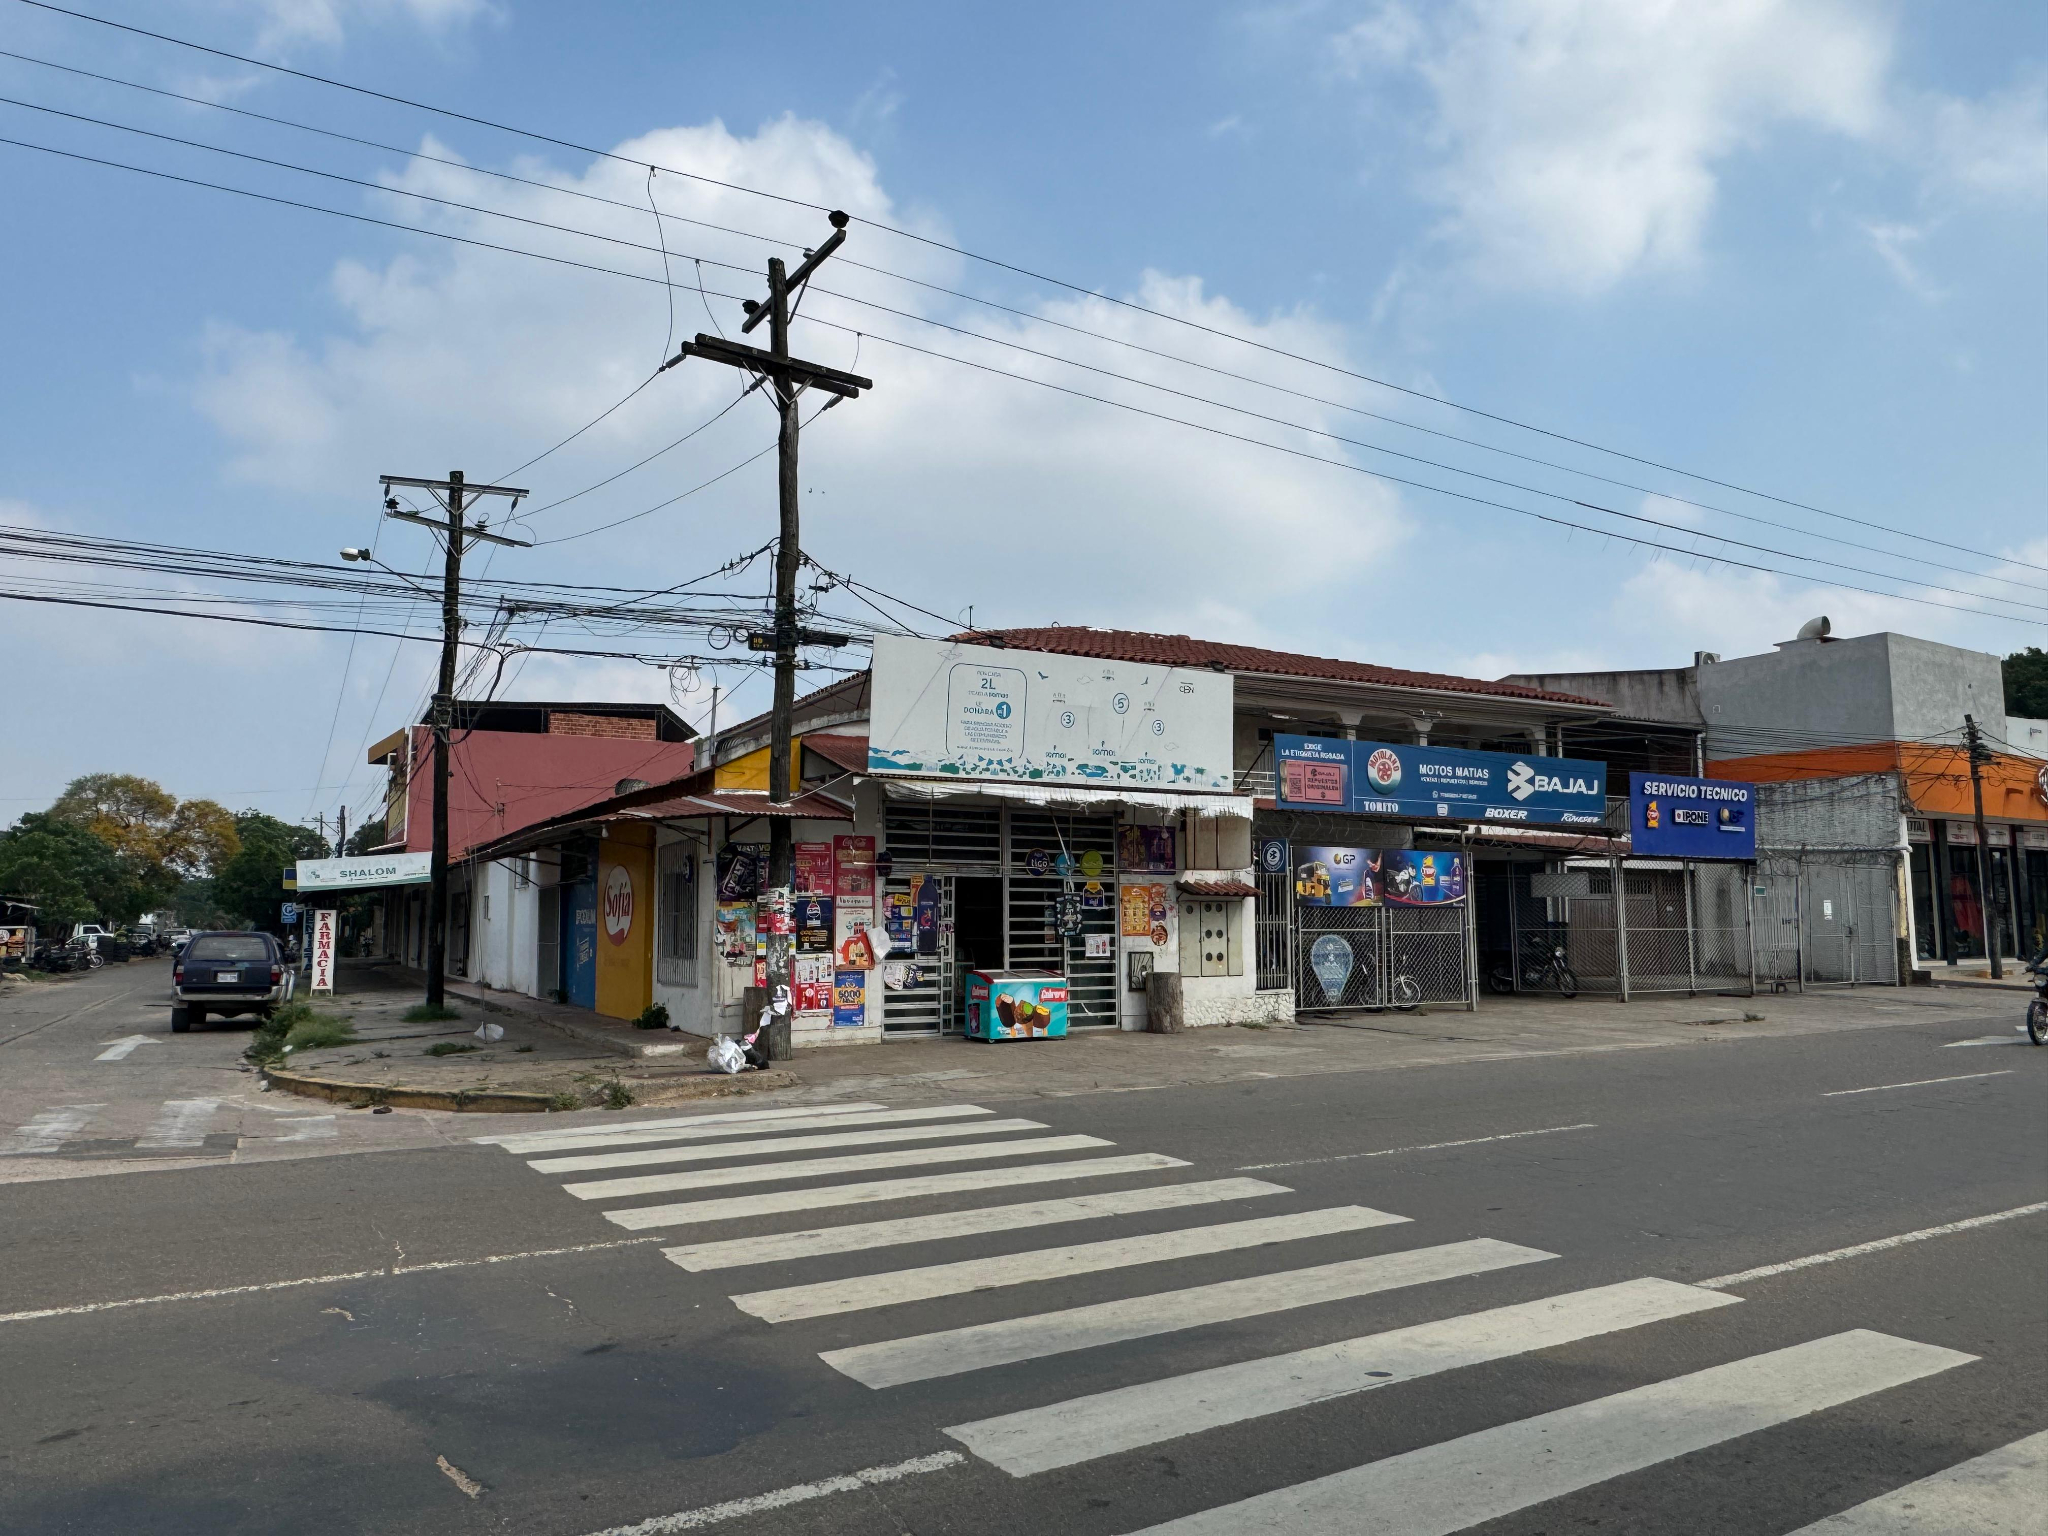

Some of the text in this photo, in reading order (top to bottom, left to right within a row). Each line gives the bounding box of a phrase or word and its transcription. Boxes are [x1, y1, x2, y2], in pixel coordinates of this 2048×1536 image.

[981, 678, 996, 690] 2L
[1419, 764, 1489, 779] MOTOS MATIAS
[1535, 775, 1598, 795] BAJAJ
[1644, 781, 1747, 802] SERVICIO TECNICO
[1364, 801, 1398, 813] TORITO
[1485, 808, 1528, 820] BOXER
[1682, 810, 1709, 823] IPONE
[340, 867, 397, 878] SHALOM
[605, 882, 631, 926] Sofía
[316, 912, 332, 987] FARMACIA
